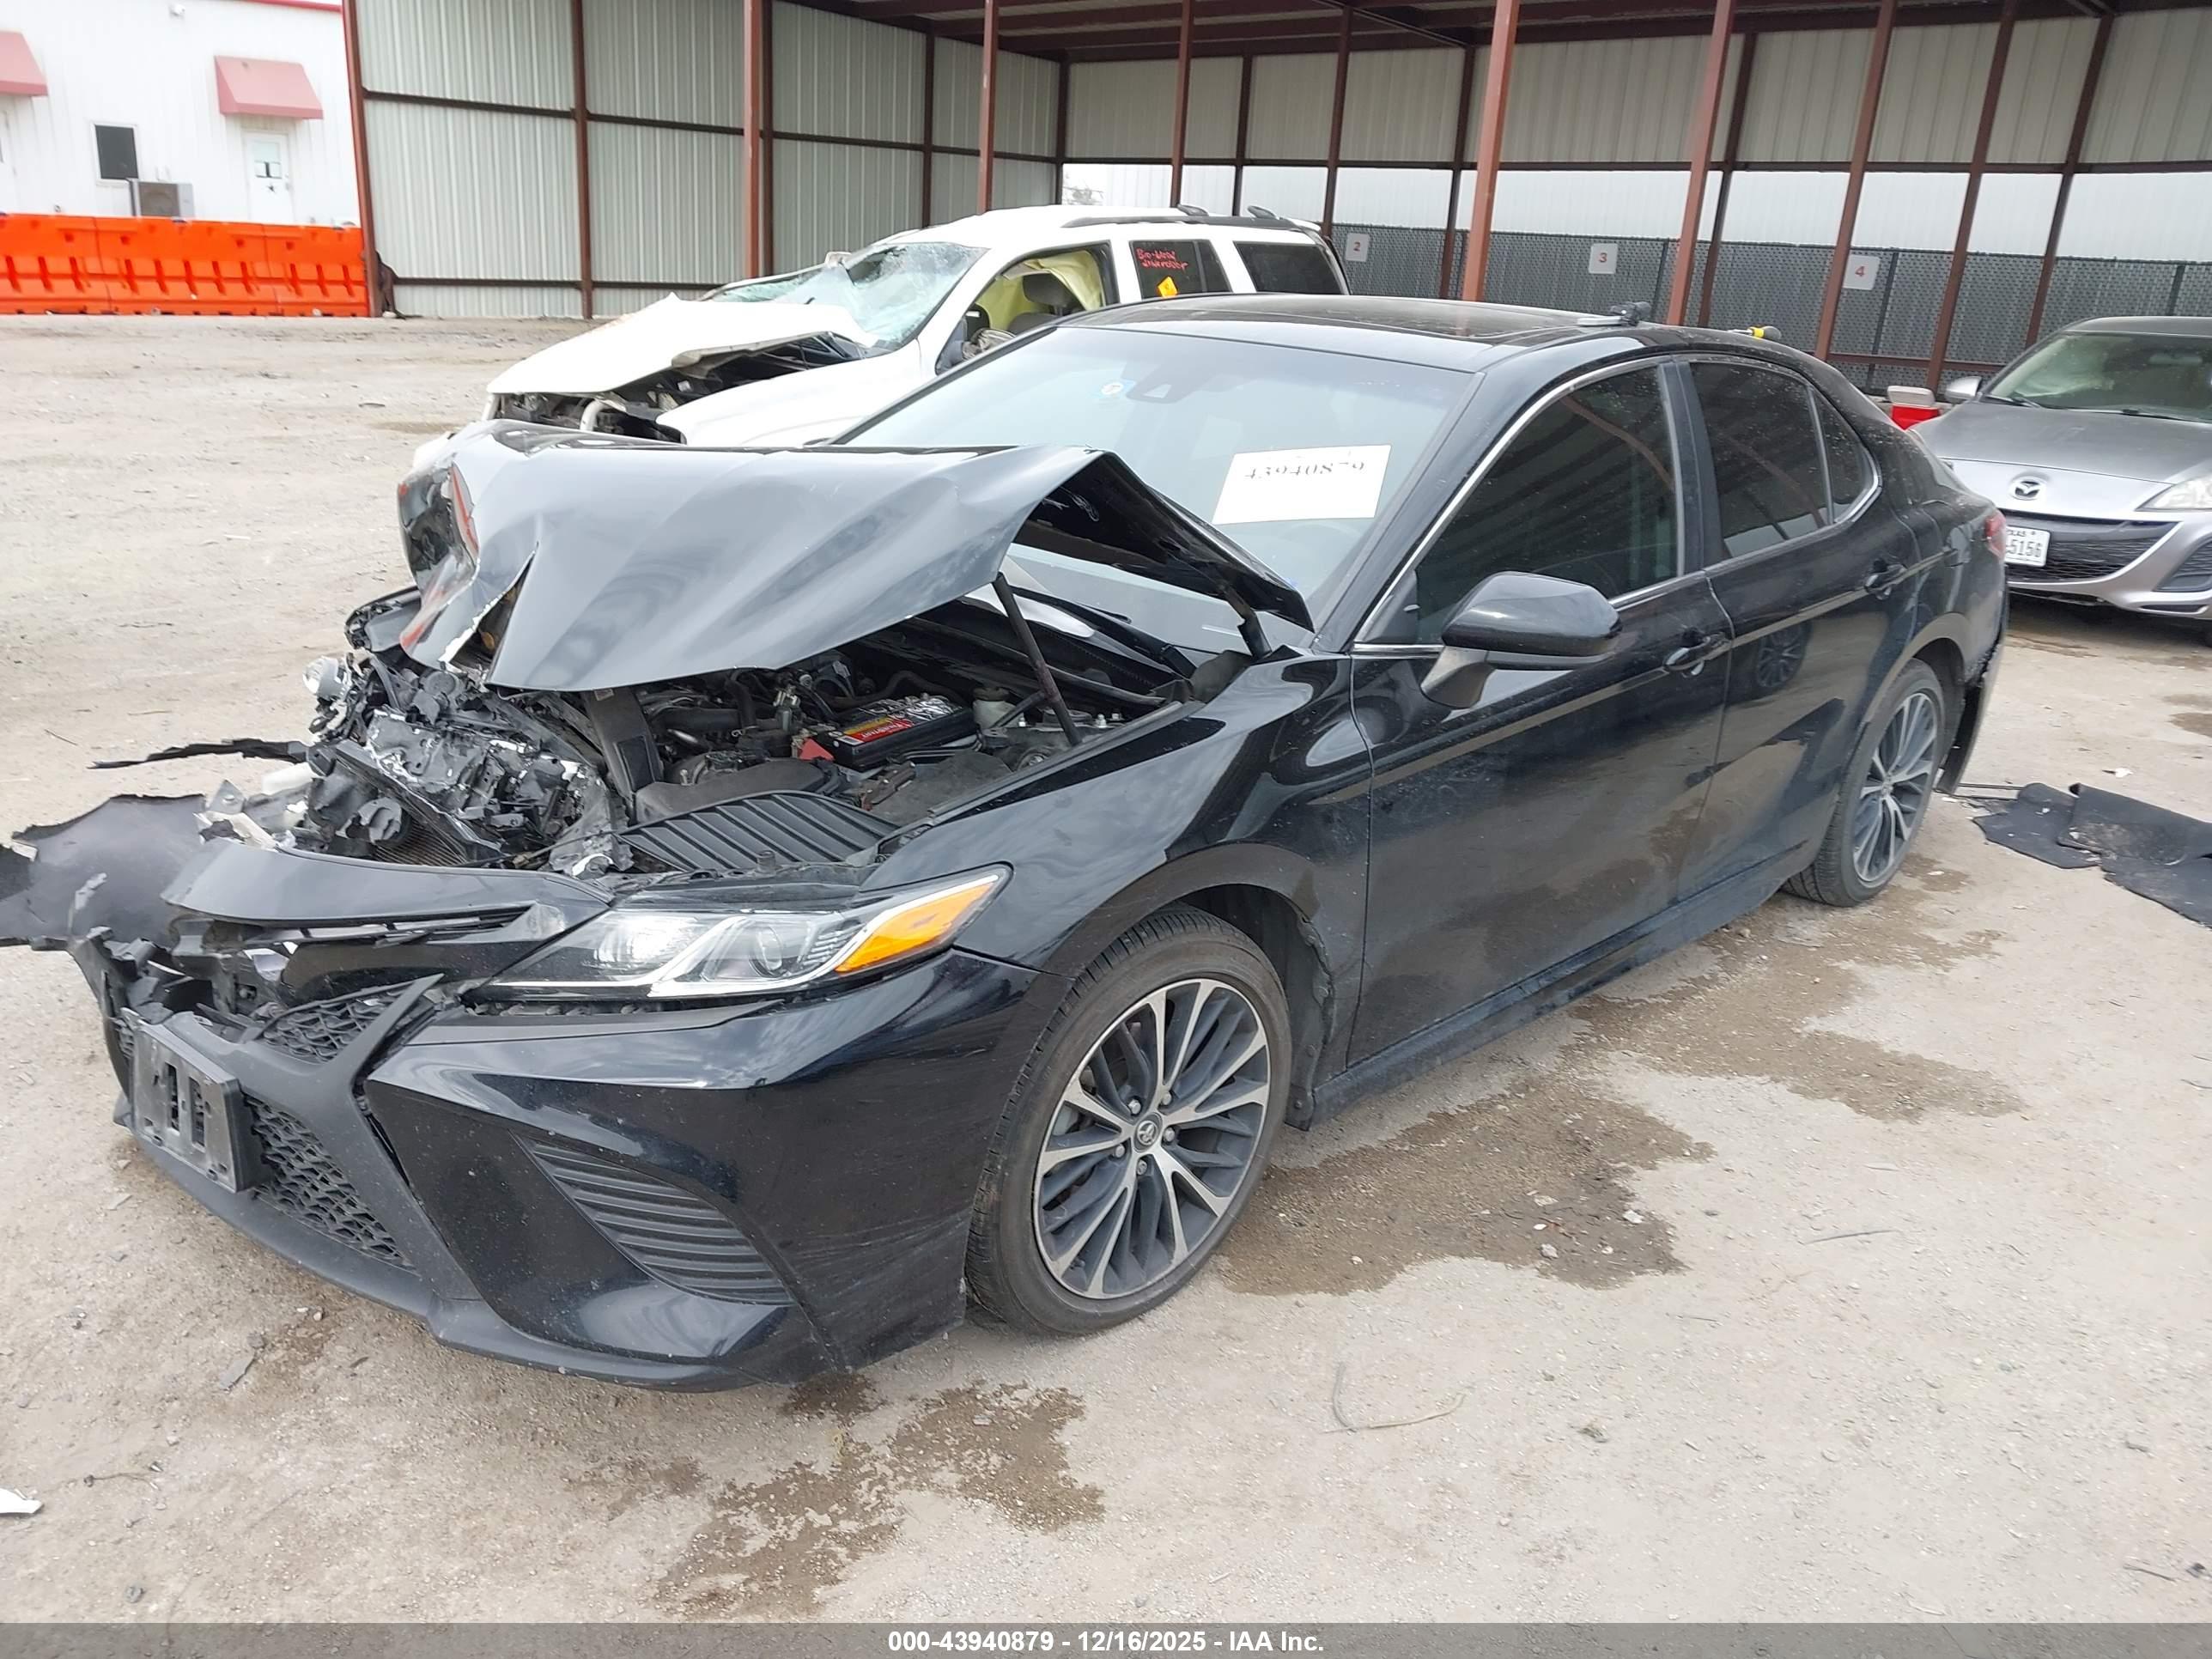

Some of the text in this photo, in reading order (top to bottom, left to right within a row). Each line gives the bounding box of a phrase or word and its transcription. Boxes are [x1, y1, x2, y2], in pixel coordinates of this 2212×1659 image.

[1353, 241, 1361, 252] 2
[1599, 252, 1607, 263] 3
[1855, 265, 1864, 276] 4
